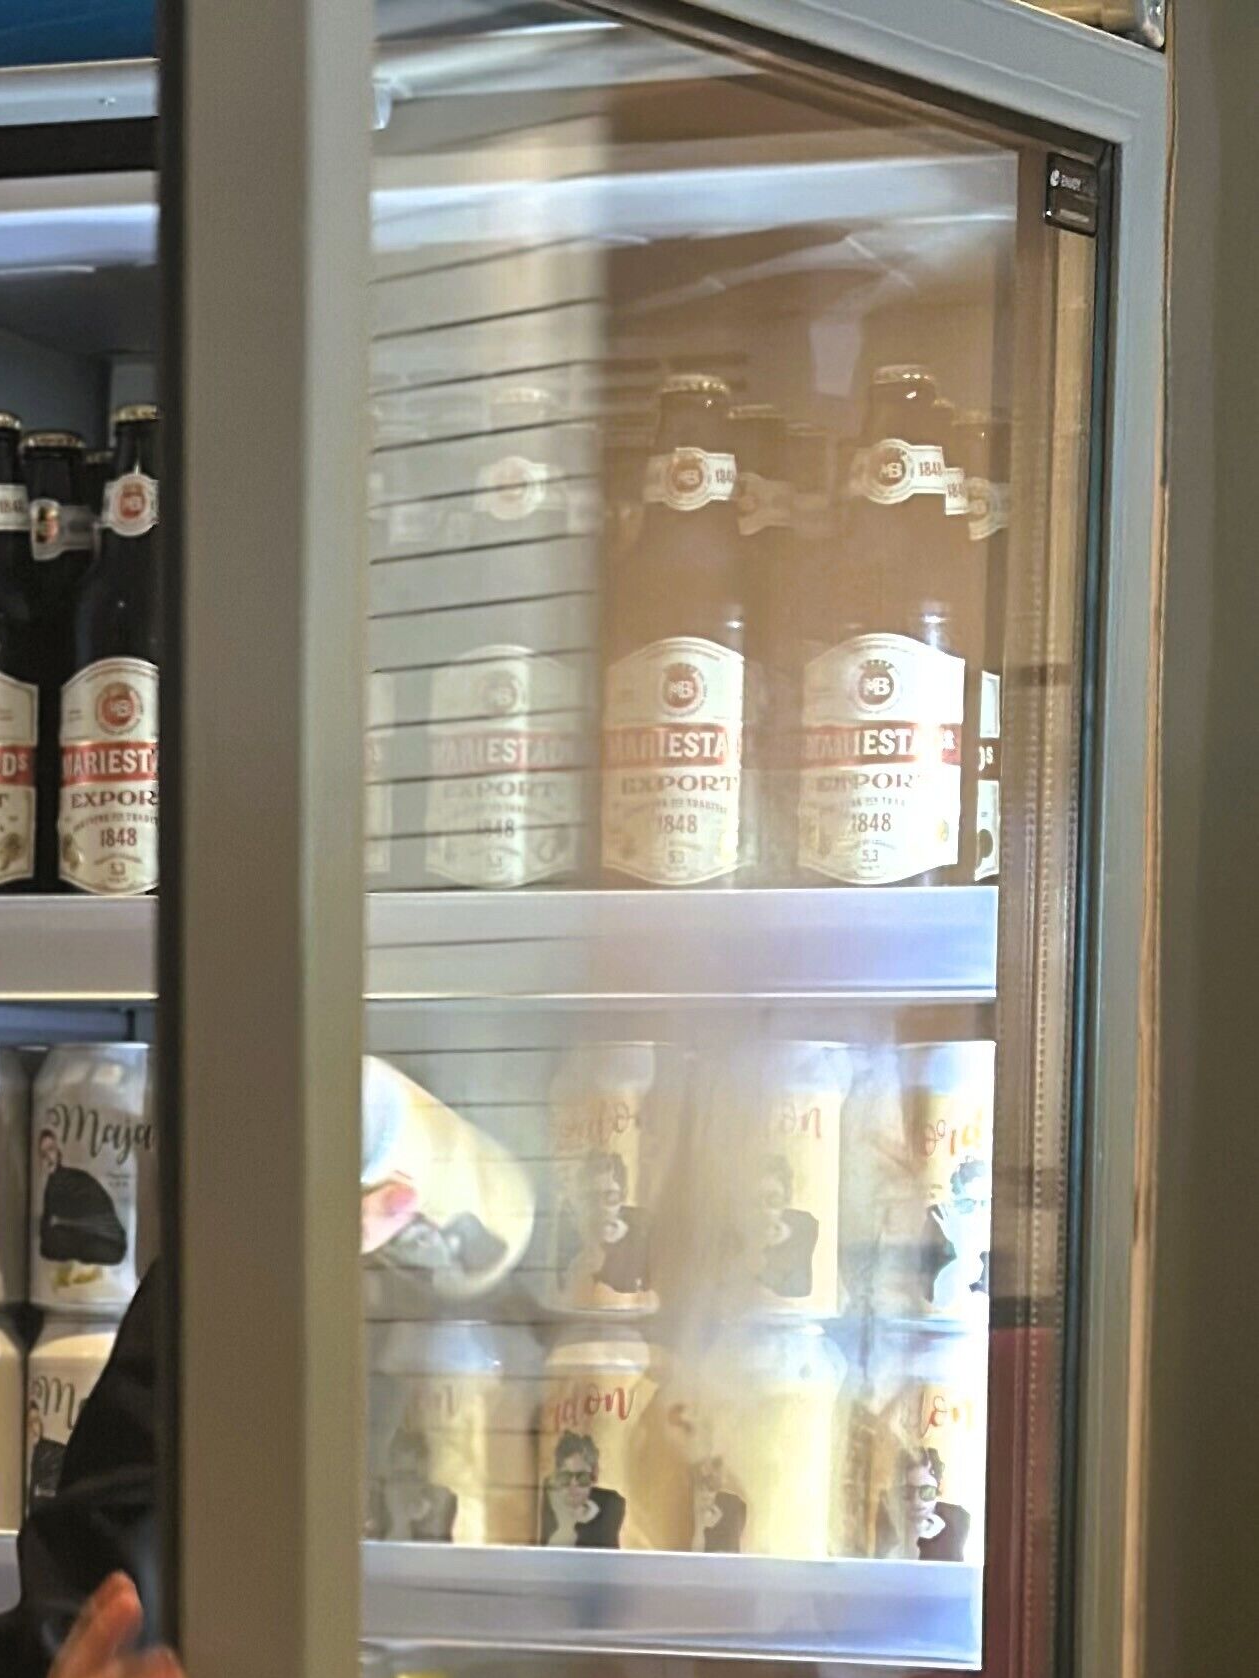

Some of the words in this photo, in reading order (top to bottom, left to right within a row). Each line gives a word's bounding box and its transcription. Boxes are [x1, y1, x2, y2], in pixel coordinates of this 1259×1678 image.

[658, 815, 699, 836] 1848
[852, 813, 892, 834] 1848
[100, 827, 137, 847] 1848
[44, 1103, 154, 1166] Maja
